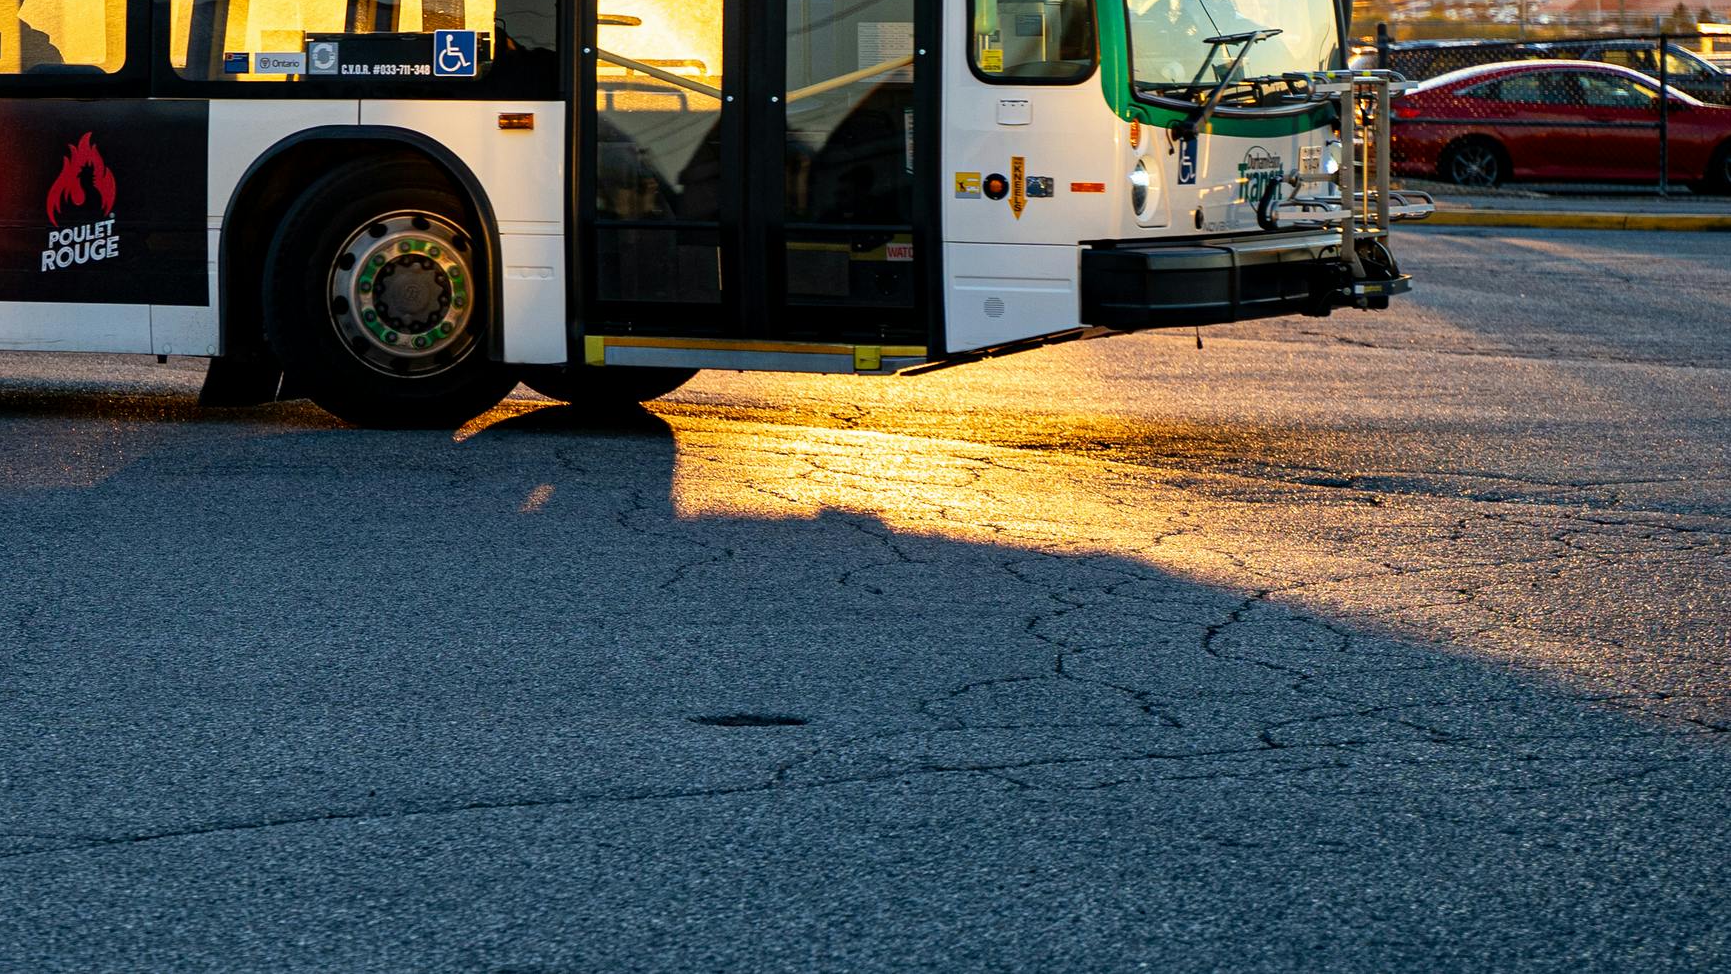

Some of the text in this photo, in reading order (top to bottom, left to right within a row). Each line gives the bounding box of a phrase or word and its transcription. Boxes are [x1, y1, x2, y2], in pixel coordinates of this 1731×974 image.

[272, 59, 300, 69] Ontario
[1013, 166, 1022, 212] KNEELS
[48, 219, 115, 248] POULET
[41, 236, 120, 272] ROUGE
